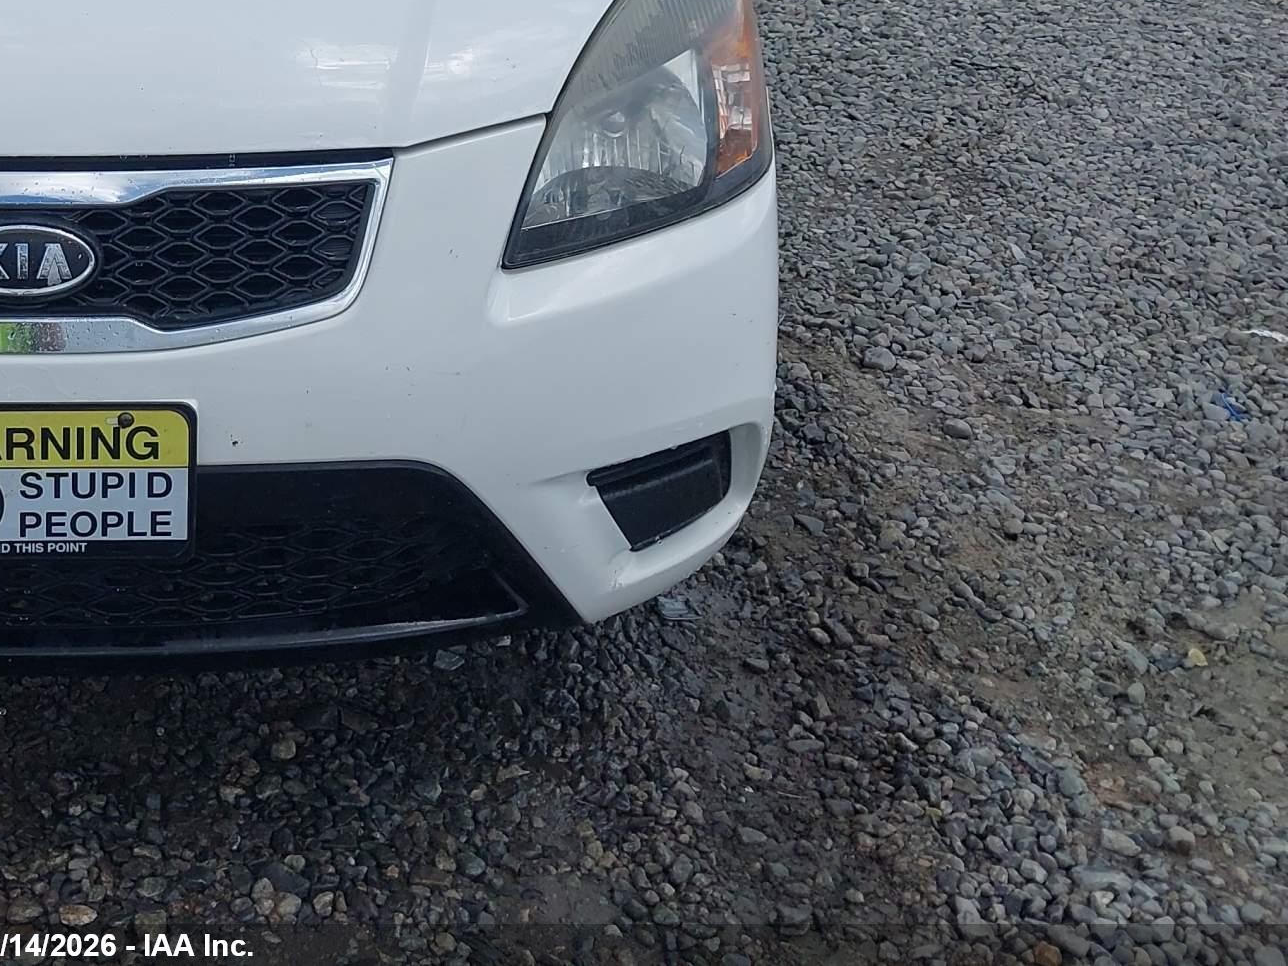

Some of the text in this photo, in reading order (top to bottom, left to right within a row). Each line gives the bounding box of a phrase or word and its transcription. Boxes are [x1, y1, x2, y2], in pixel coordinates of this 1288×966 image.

[19, 471, 173, 500] STUPID
[19, 510, 173, 538] PEOPLE
[13, 543, 44, 553] THIS
[47, 542, 88, 553] POINT
